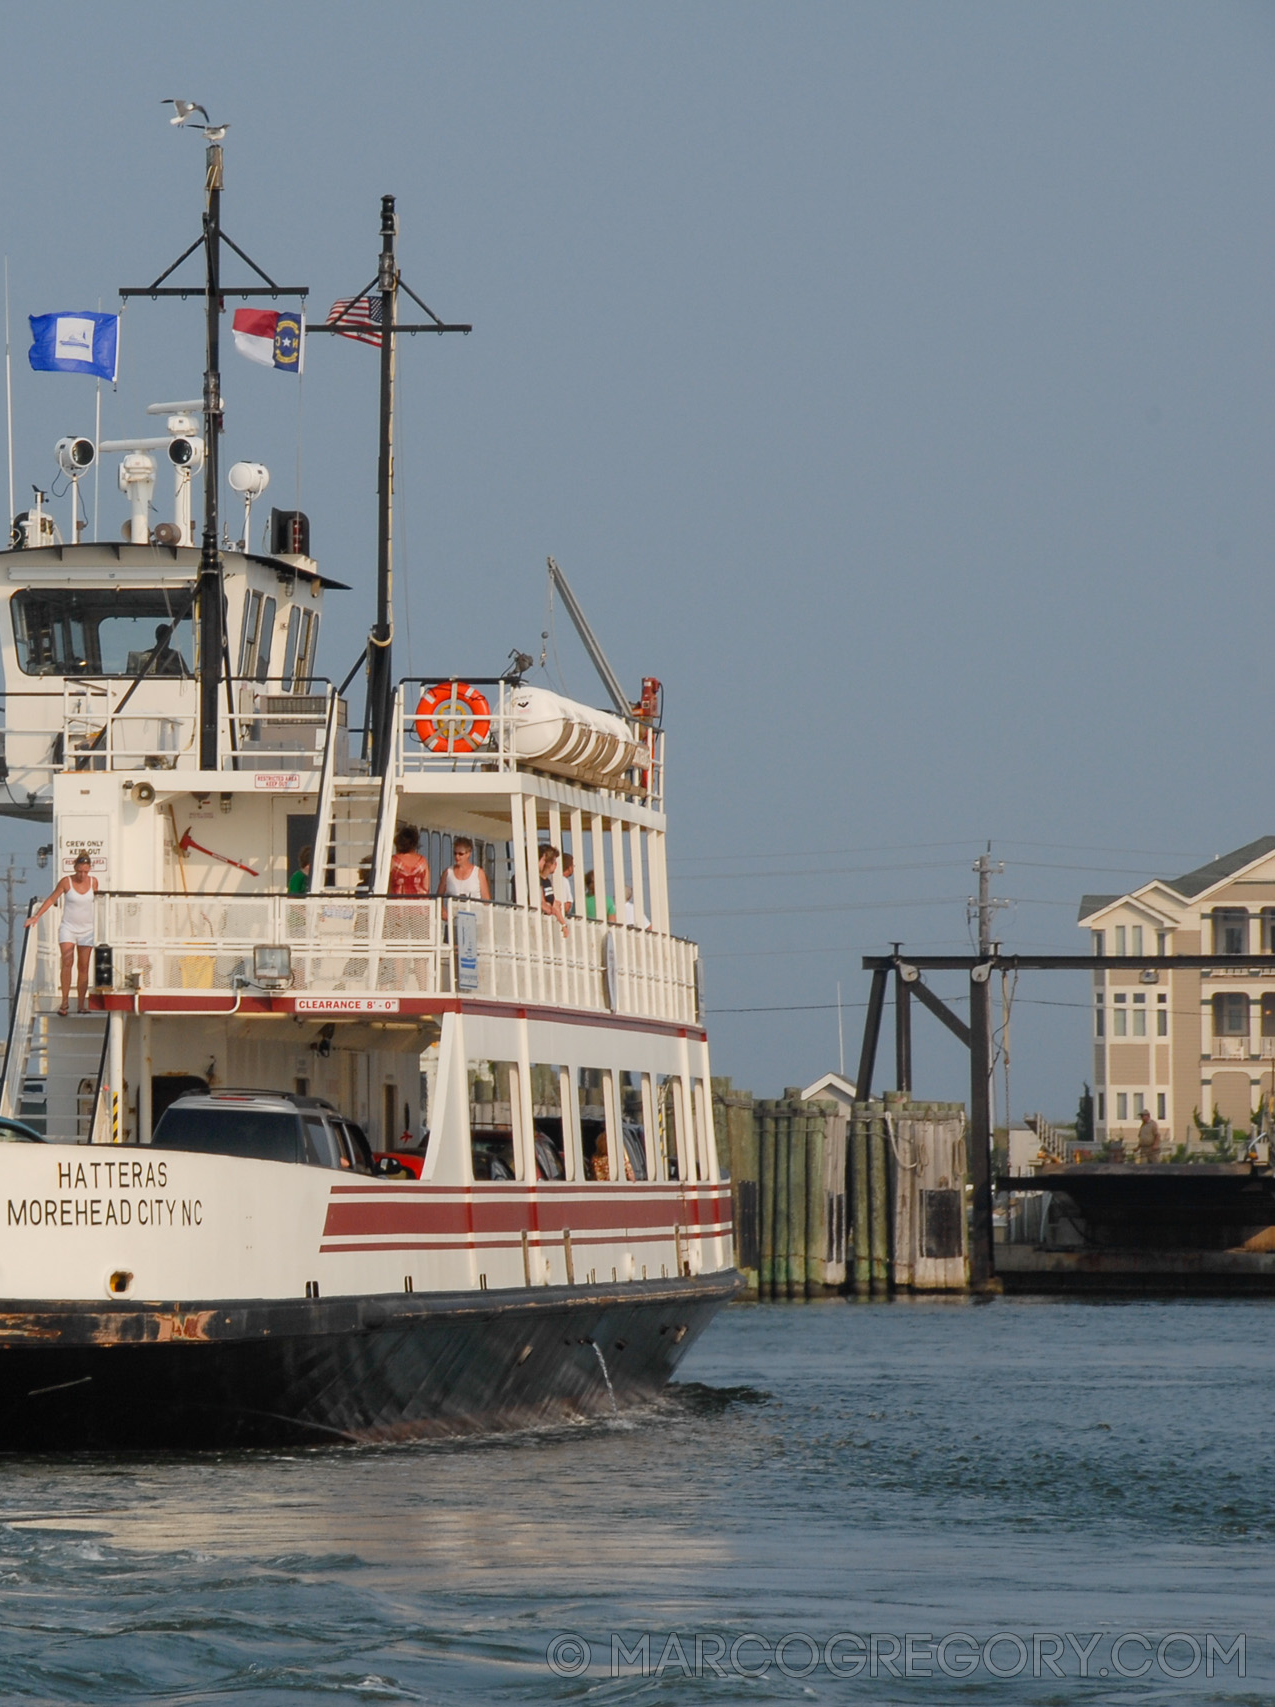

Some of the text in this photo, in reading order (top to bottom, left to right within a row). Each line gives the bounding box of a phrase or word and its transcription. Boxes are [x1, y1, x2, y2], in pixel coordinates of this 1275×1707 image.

[299, 1000, 361, 1009] CLEARANCE
[58, 1161, 168, 1189] HATTERAS
[7, 1199, 203, 1226] MOREHEAD CITY NC
